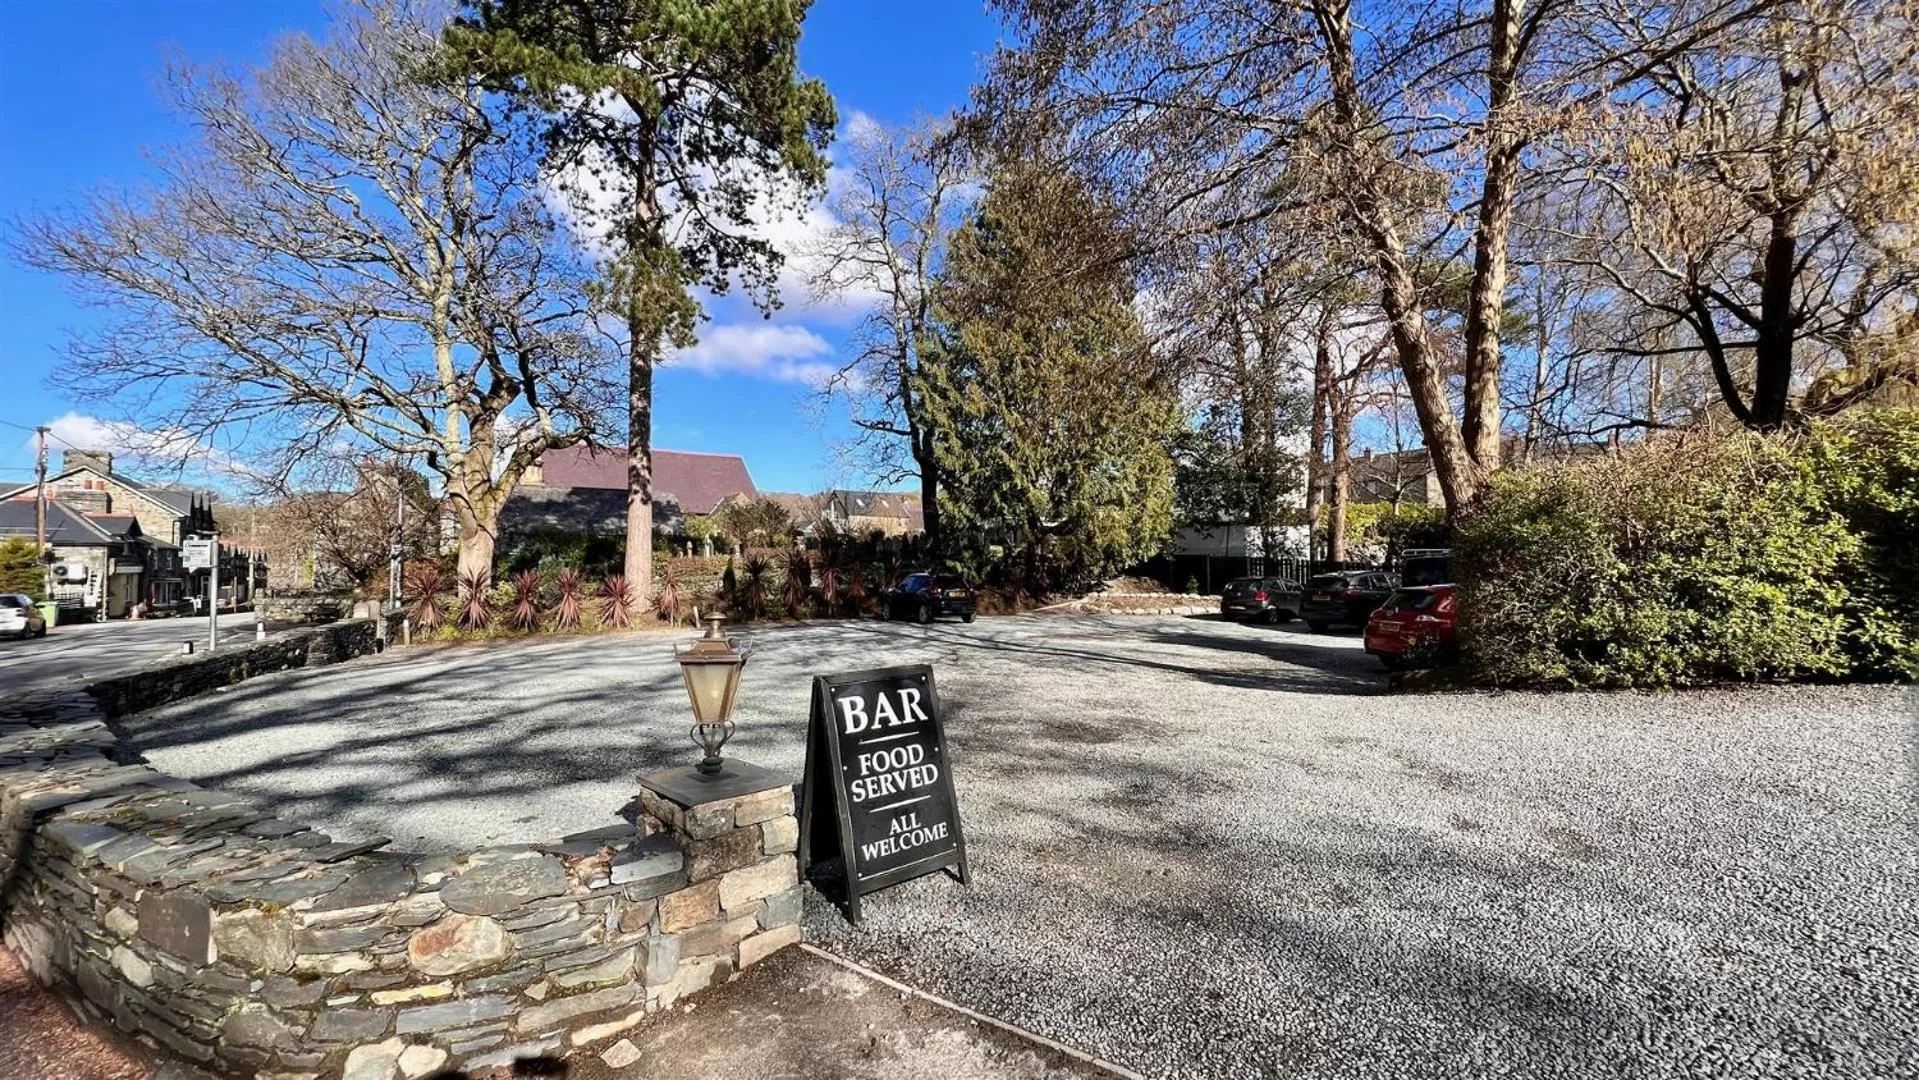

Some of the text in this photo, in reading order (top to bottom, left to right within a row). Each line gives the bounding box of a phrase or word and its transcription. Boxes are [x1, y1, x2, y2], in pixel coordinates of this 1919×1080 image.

[838, 688, 928, 734] BAR
[859, 744, 924, 776] FOOD
[852, 764, 938, 802] SERVED
[862, 822, 948, 861] WELCOME
[889, 813, 921, 836] ALL
